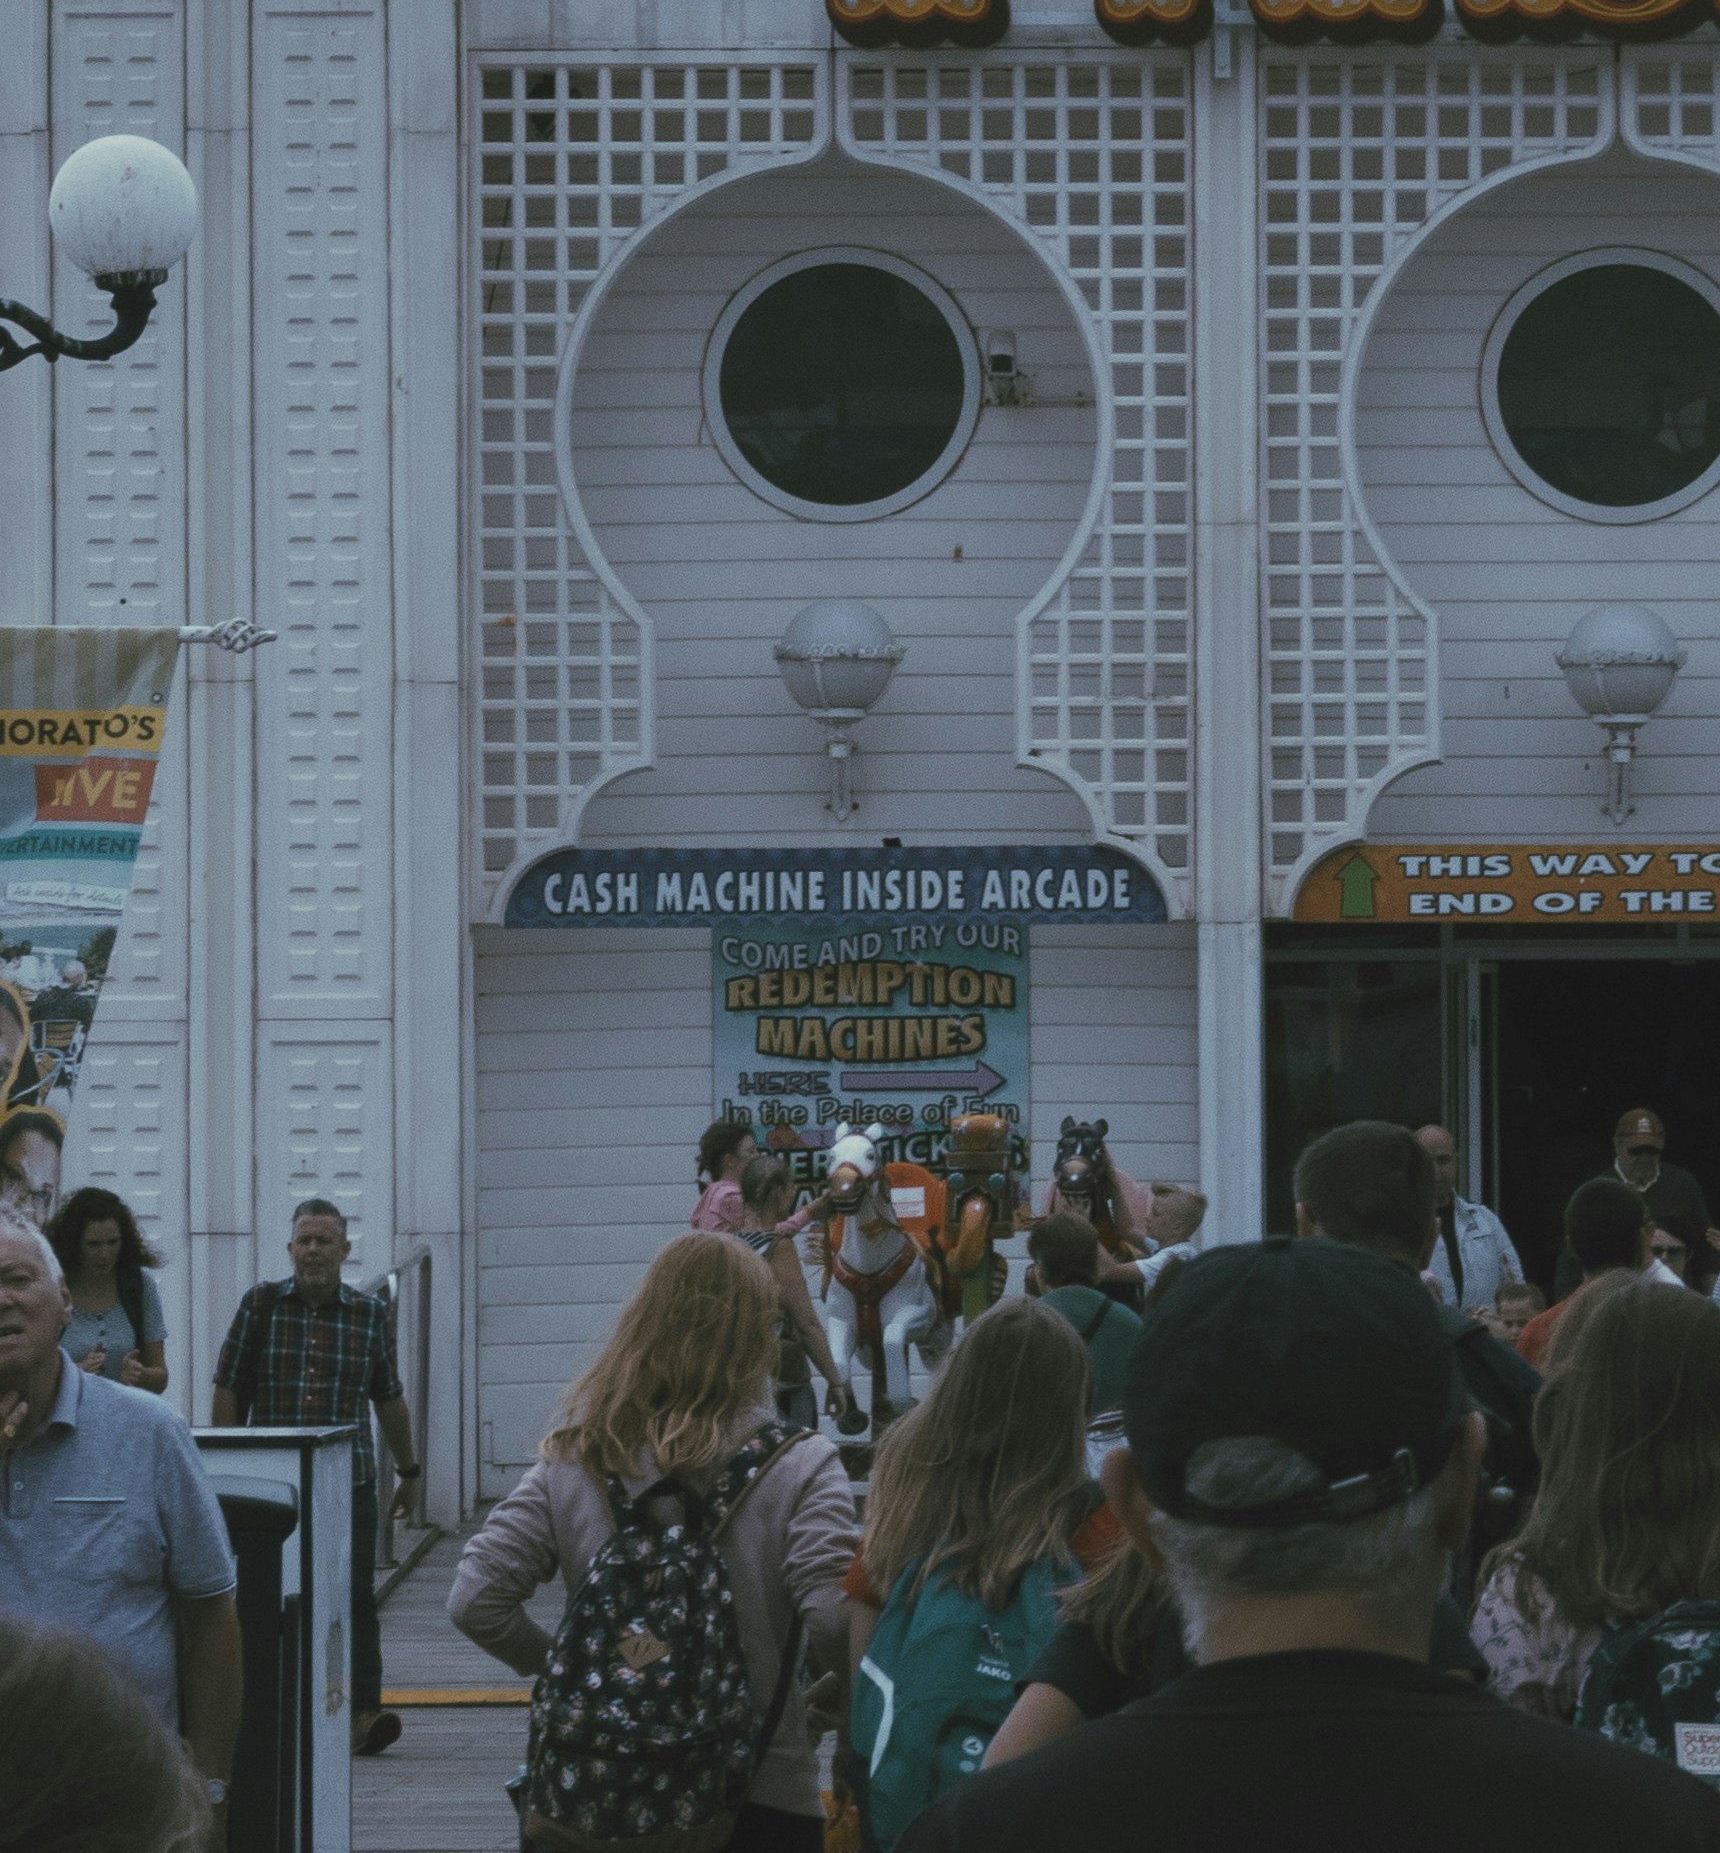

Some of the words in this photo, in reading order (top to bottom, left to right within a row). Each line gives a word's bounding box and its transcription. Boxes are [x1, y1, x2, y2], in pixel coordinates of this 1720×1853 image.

[1398, 853, 1512, 877] THIS
[1530, 853, 1653, 876] WAY
[543, 872, 640, 914] CASH
[655, 870, 827, 914] MACHINE
[841, 869, 963, 912] INSIDE
[980, 868, 1132, 911] ARCADE
[1410, 892, 1514, 915] END
[1534, 891, 1600, 914] OF
[1620, 890, 1716, 913] THE
[721, 935, 808, 969] COME
[817, 932, 883, 967] AND
[890, 924, 947, 953] TRY
[956, 924, 1022, 955] OUR
[726, 959, 1017, 1011] REDEMPTION
[756, 1013, 986, 1063] MACHINES
[737, 1071, 831, 1096] HERE
[721, 1098, 751, 1125] In
[760, 1098, 808, 1125] the
[816, 1097, 913, 1125] Palace
[922, 1095, 957, 1125] of
[976, 1662, 1012, 1682] JAKO
